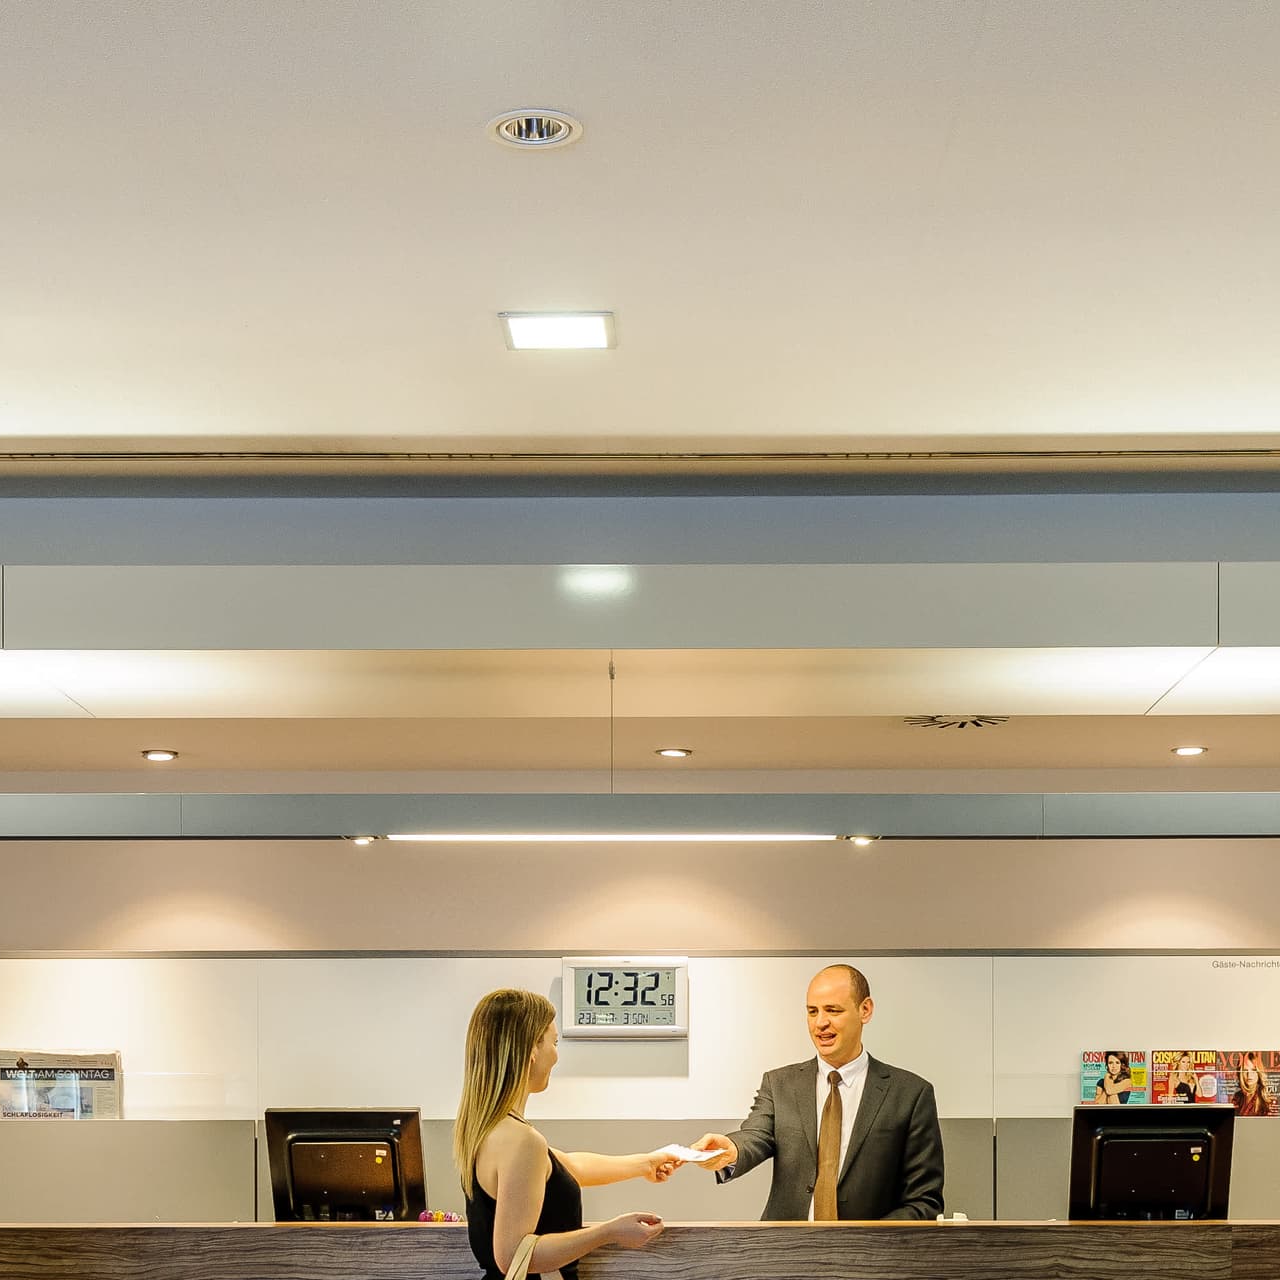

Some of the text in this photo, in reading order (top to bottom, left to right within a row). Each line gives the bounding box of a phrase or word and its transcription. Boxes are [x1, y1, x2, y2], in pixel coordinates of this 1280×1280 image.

[586, 972, 660, 1006] 12:32
[1083, 1051, 1145, 1063] COSMITAN
[1153, 1051, 1216, 1064] COSMLITAN
